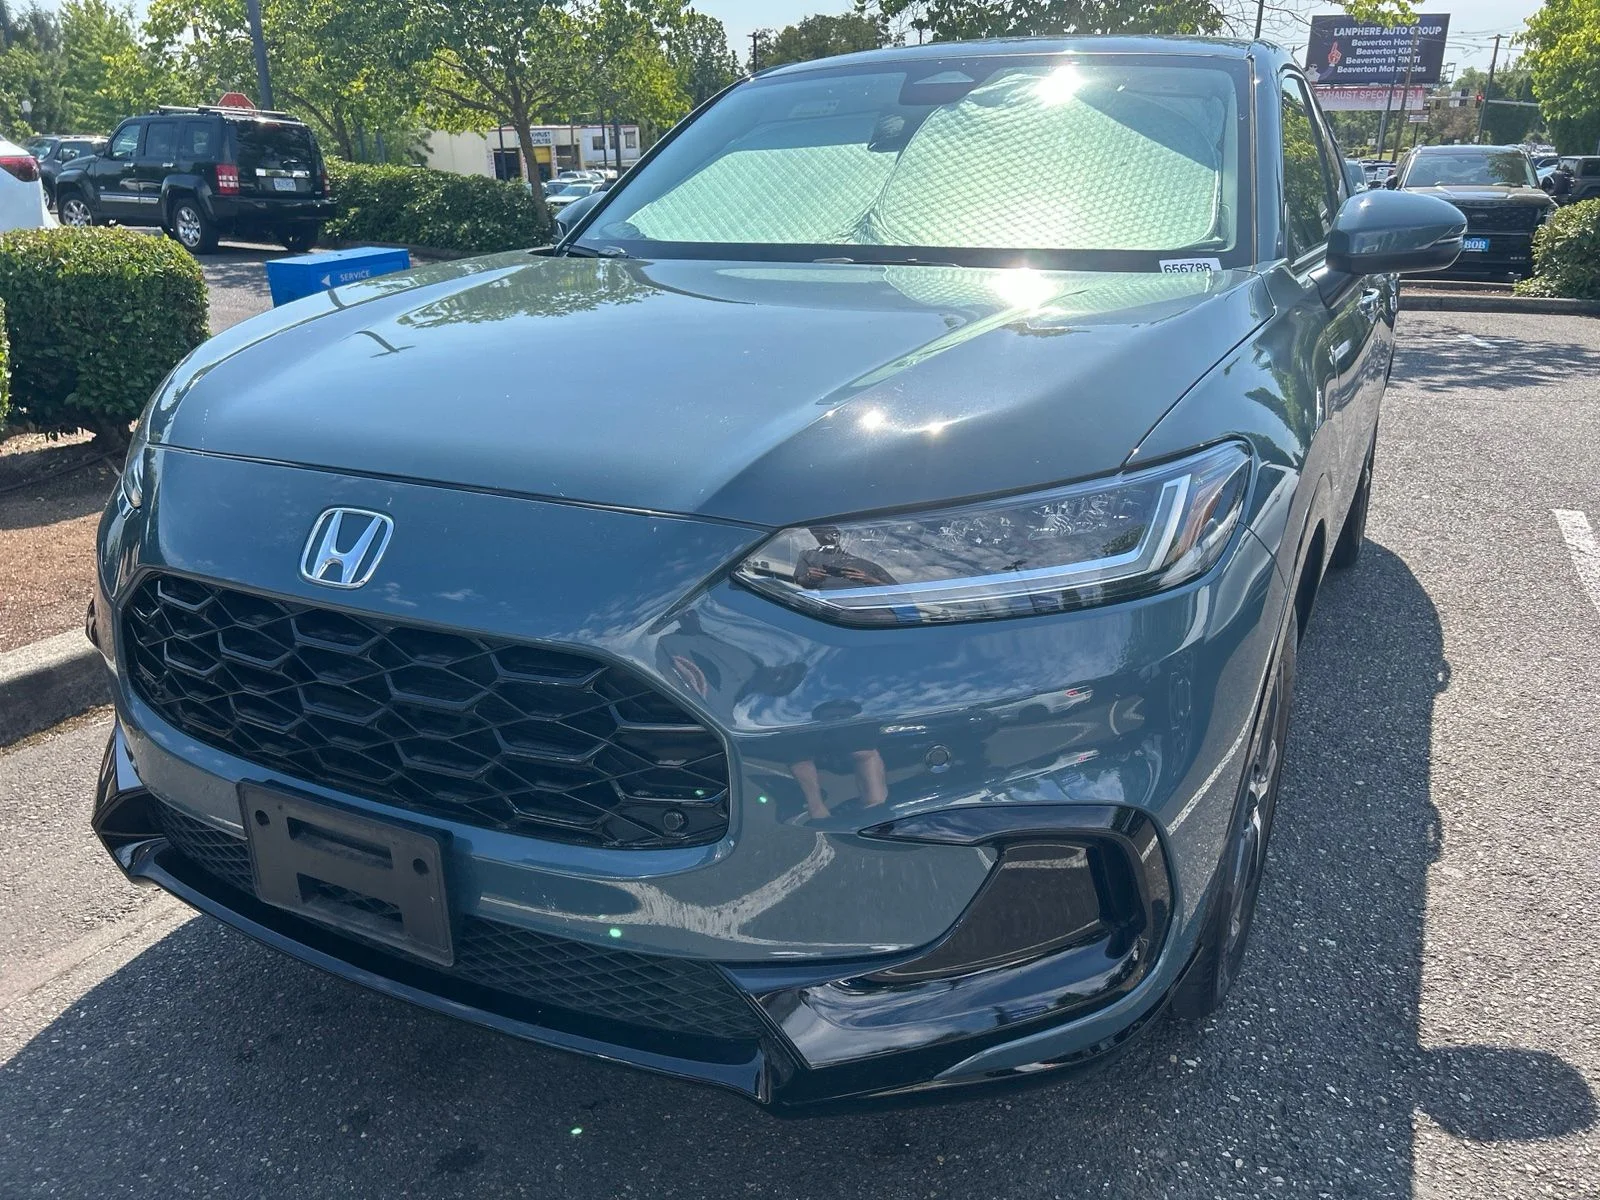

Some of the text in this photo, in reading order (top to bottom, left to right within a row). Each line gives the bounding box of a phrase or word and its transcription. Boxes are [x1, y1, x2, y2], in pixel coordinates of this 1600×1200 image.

[1333, 27, 1381, 37] LANPHERE
[1382, 26, 1408, 36] AUTO
[1351, 39, 1392, 47] Beaverton
[1356, 47, 1412, 56] Beaverton KIA
[1345, 55, 1421, 65] Beaverton INFINTI
[1337, 65, 1426, 73] Beaverton Motorccles
[1464, 240, 1486, 249] BOB
[339, 269, 370, 282] SERVICE
